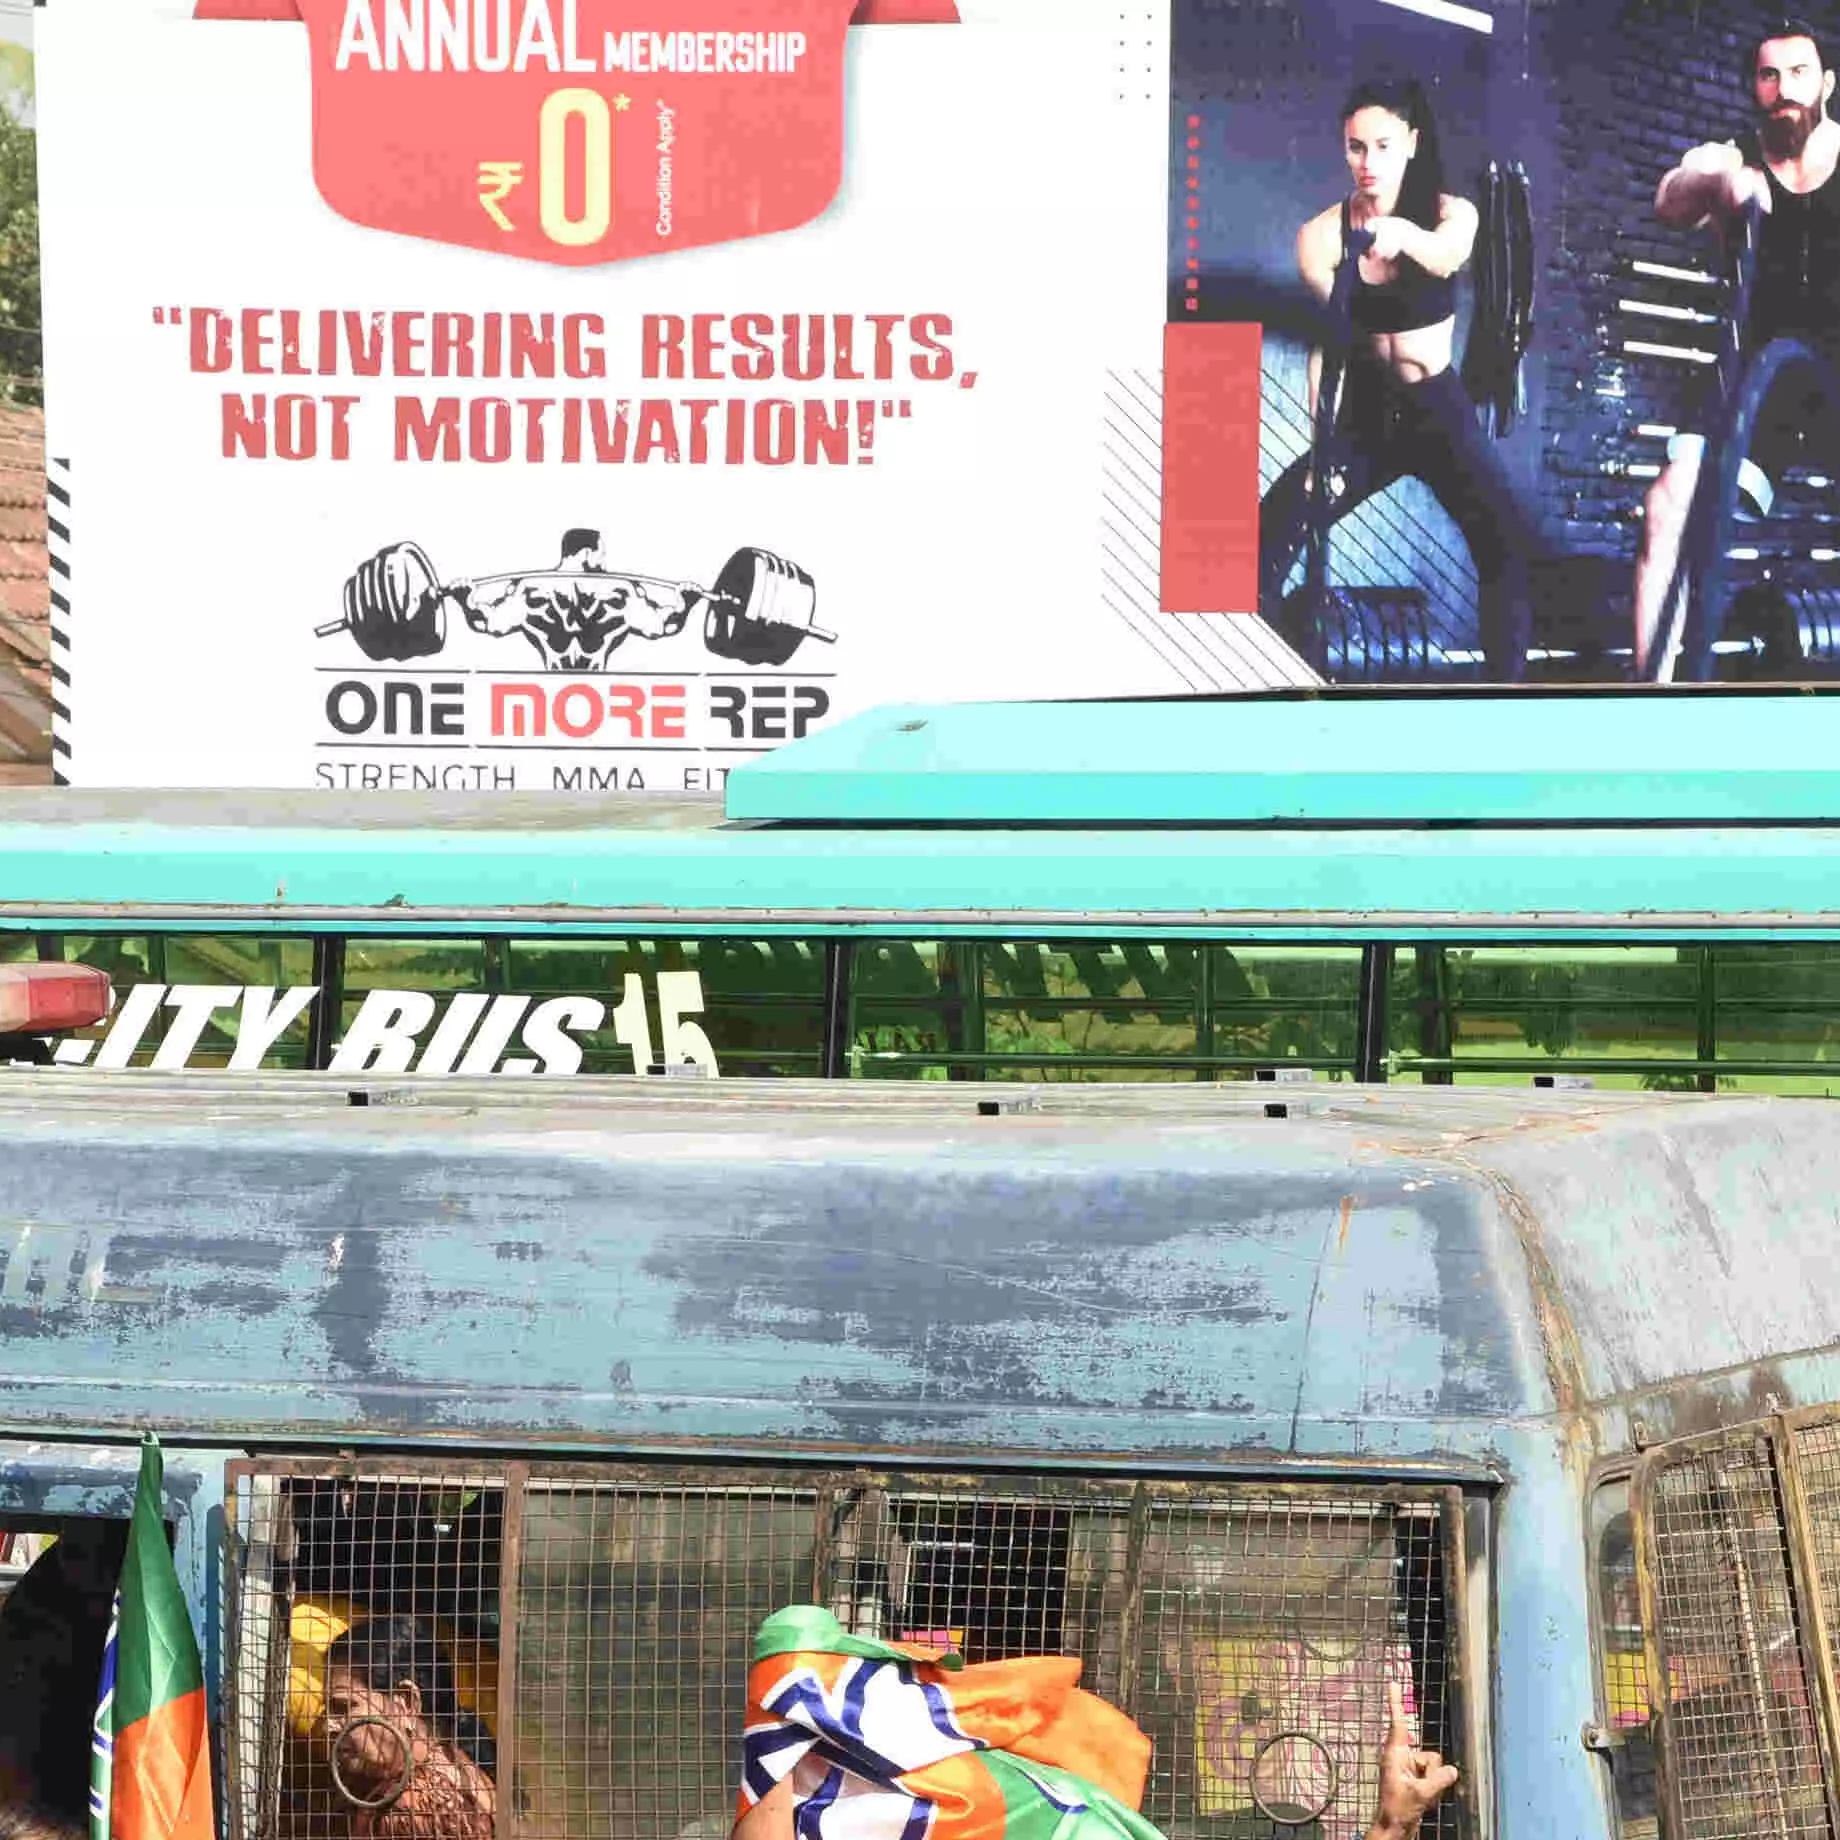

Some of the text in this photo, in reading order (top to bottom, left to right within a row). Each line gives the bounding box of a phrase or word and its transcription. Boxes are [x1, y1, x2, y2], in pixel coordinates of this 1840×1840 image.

[335, 0, 806, 73] ANNUAL MEMBERSHIP
[655, 157, 673, 236] Condition
[642, 311, 977, 389] RESULTS,
[220, 394, 360, 460] NOT
[325, 680, 830, 738] ONE MORE REP
[314, 763, 515, 790] STRENGTH
[553, 766, 646, 790] MMA
[40, 984, 321, 1069] ITY
